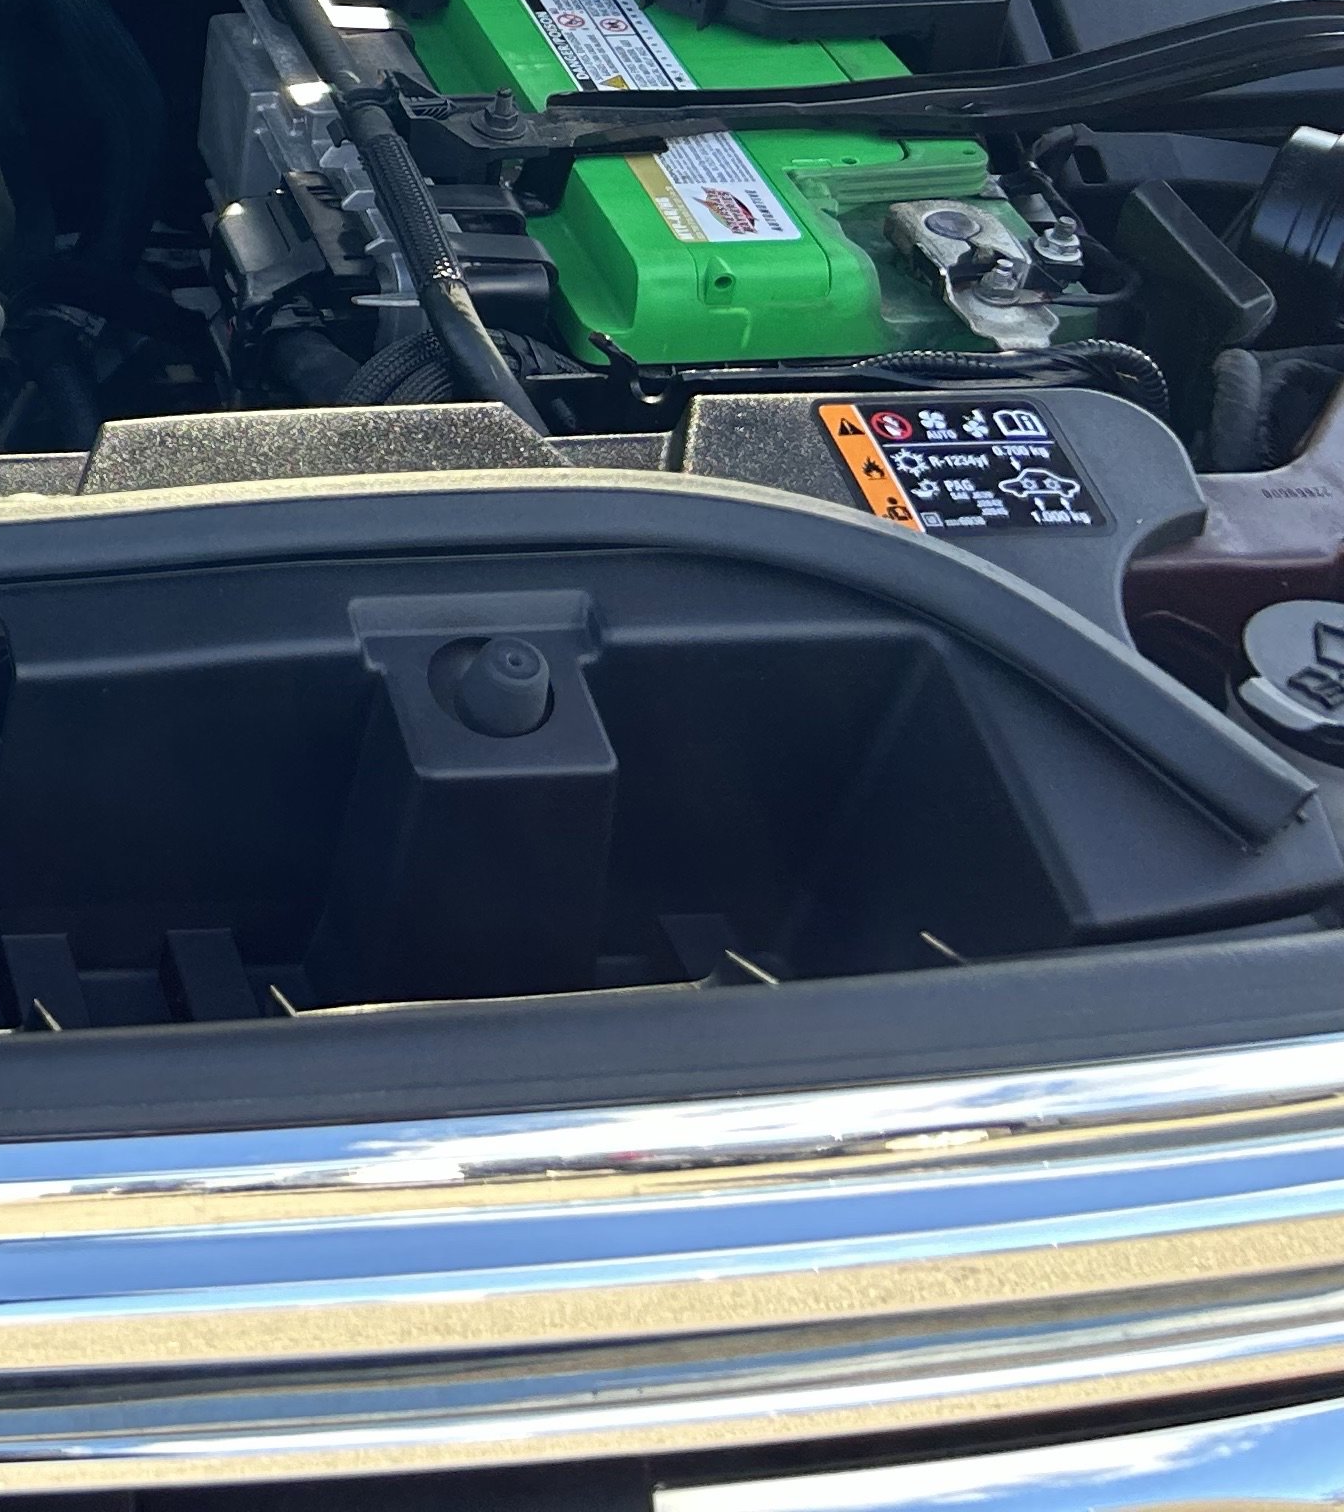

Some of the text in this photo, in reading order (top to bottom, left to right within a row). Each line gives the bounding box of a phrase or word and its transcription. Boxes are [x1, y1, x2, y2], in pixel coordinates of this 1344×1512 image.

[926, 430, 958, 440] AUTO
[928, 454, 990, 470] R-1234yf
[943, 479, 976, 492] PAG
